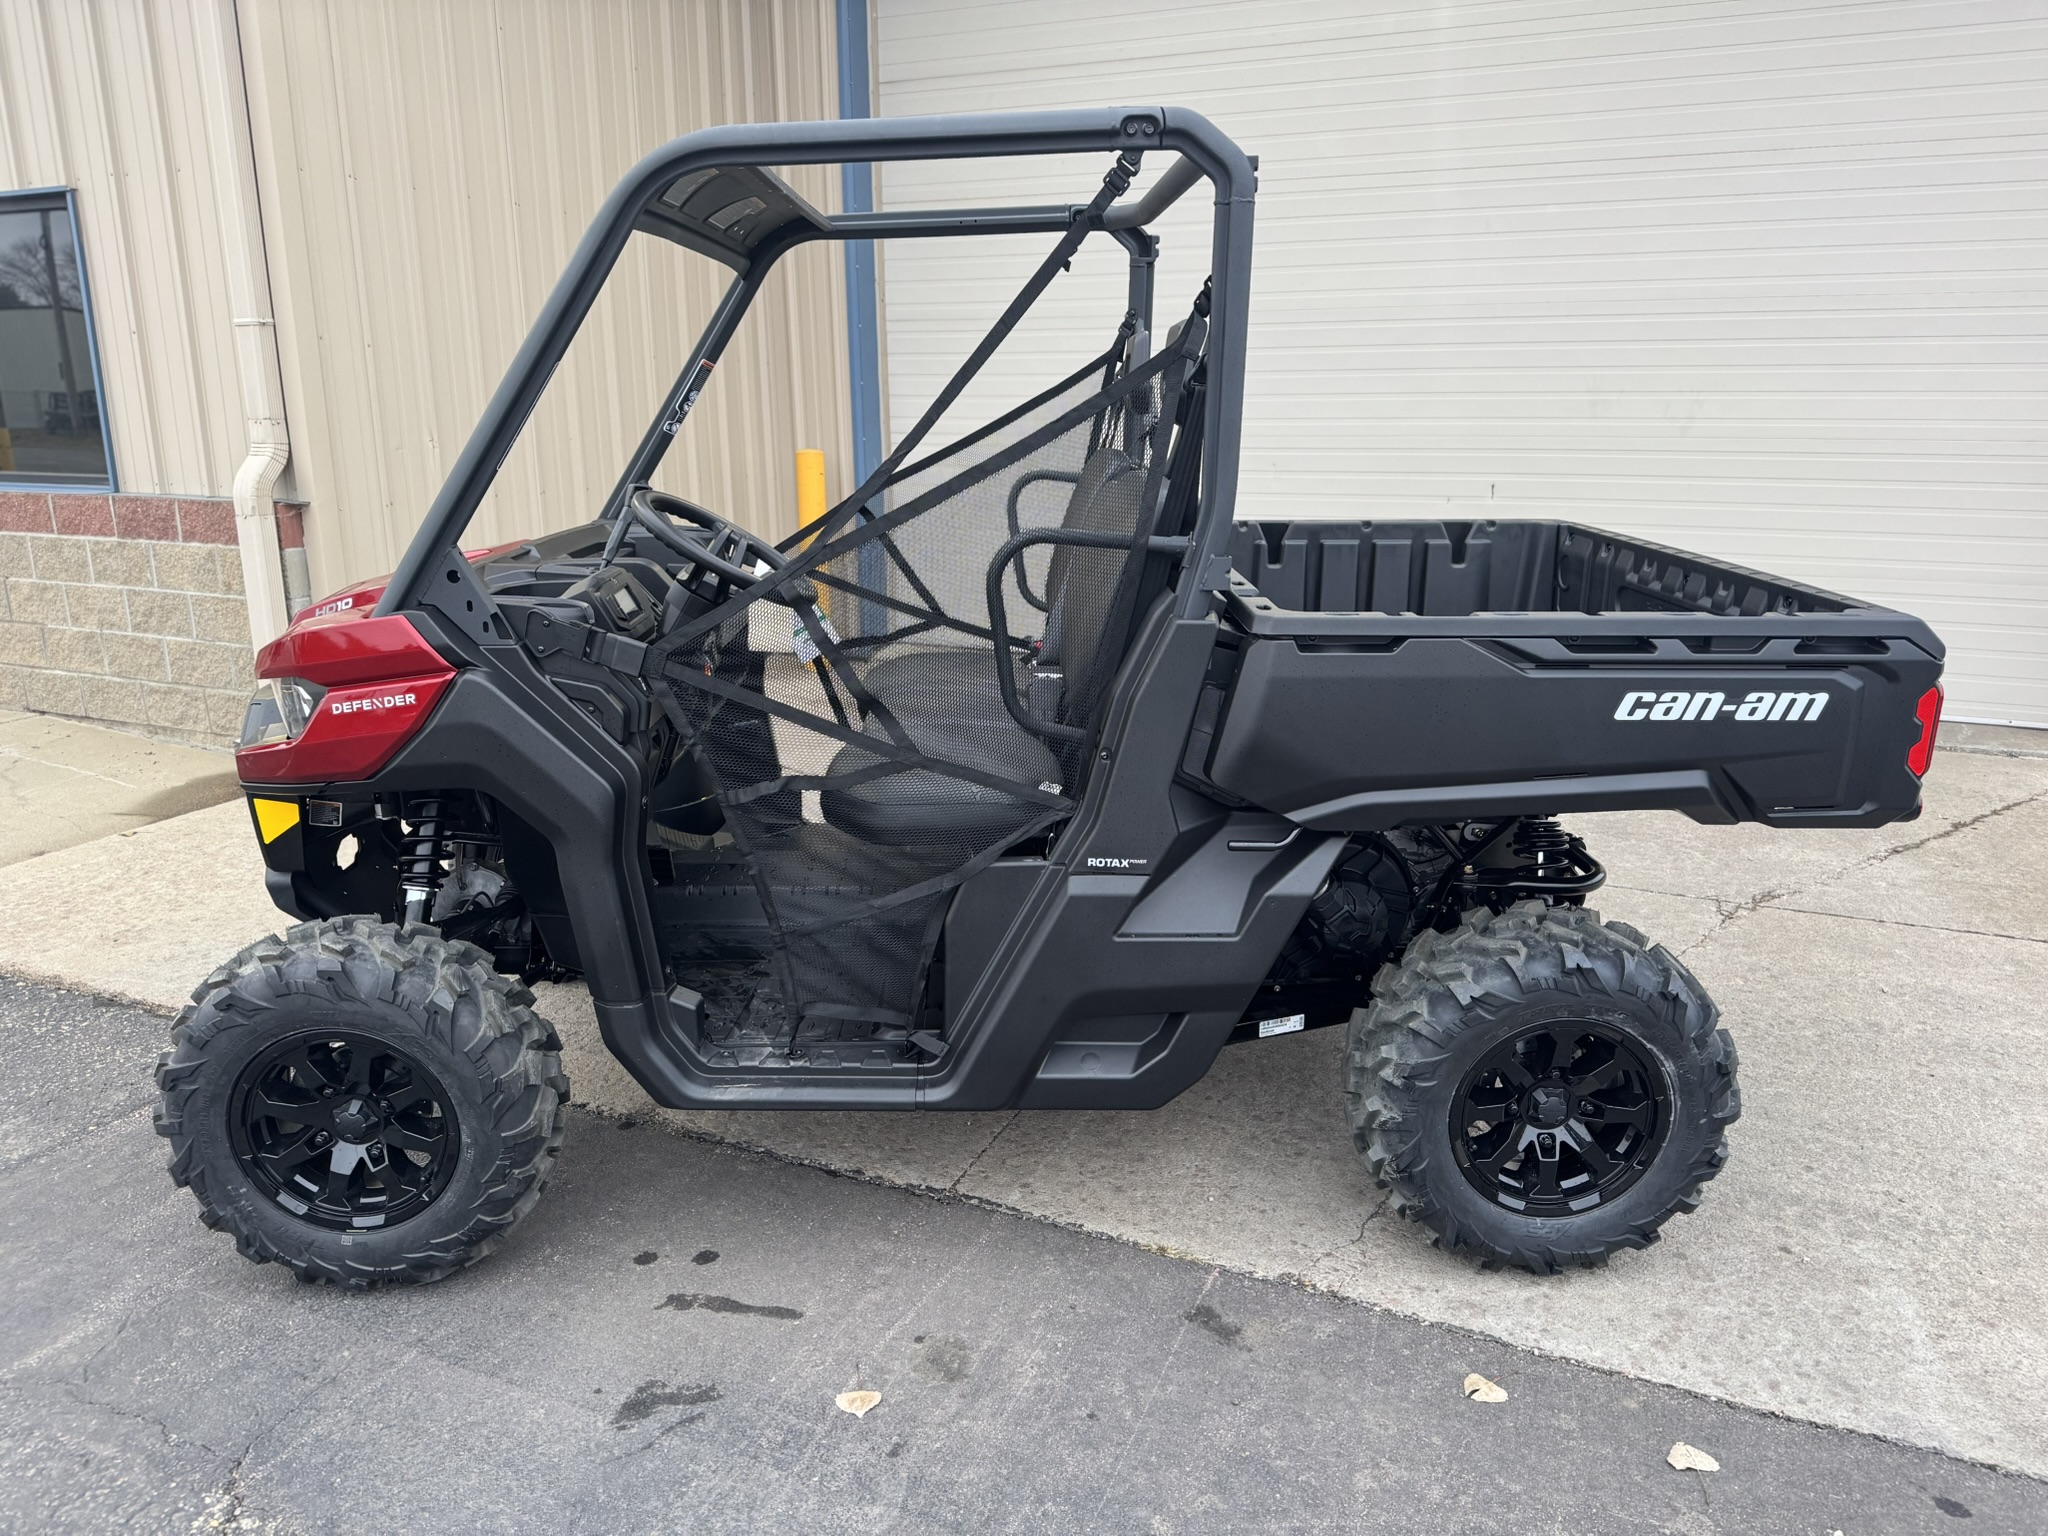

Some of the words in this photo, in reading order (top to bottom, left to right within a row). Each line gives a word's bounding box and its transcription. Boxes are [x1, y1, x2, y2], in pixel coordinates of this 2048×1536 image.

[315, 598, 352, 617] HD10
[332, 694, 416, 714] DEFENDER
[1613, 691, 1830, 721] can-am
[1087, 857, 1129, 868] ROTAX
